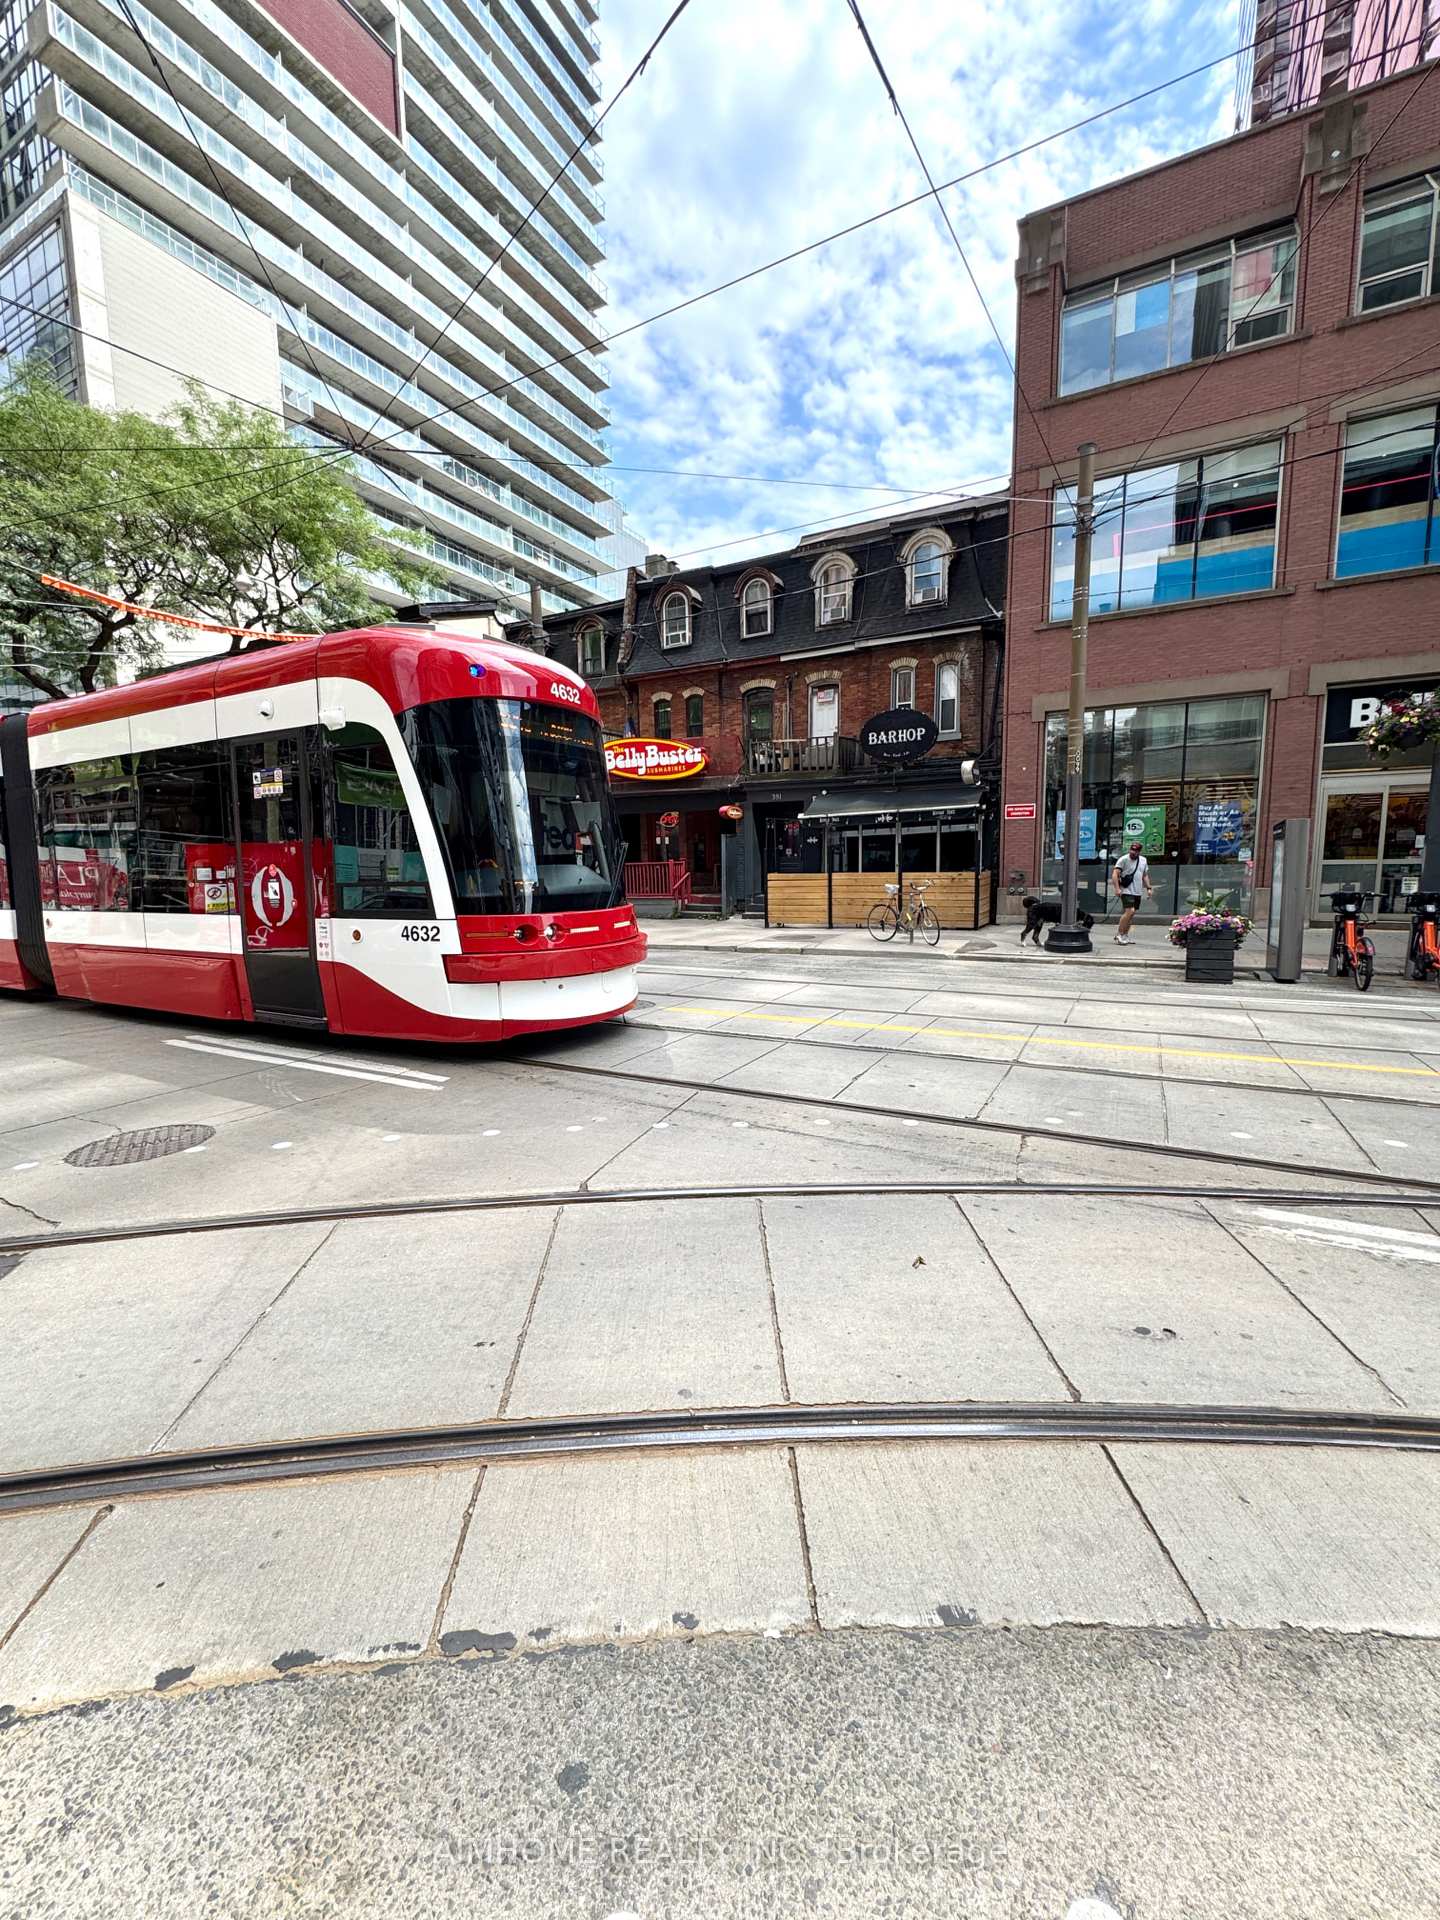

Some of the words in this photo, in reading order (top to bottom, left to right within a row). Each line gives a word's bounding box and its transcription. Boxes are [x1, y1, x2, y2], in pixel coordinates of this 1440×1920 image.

[550, 682, 581, 704] 4632
[868, 727, 926, 745] BARHOP
[613, 746, 624, 754] The
[647, 766, 687, 774] SUBMARINES
[400, 925, 441, 942] 4632
